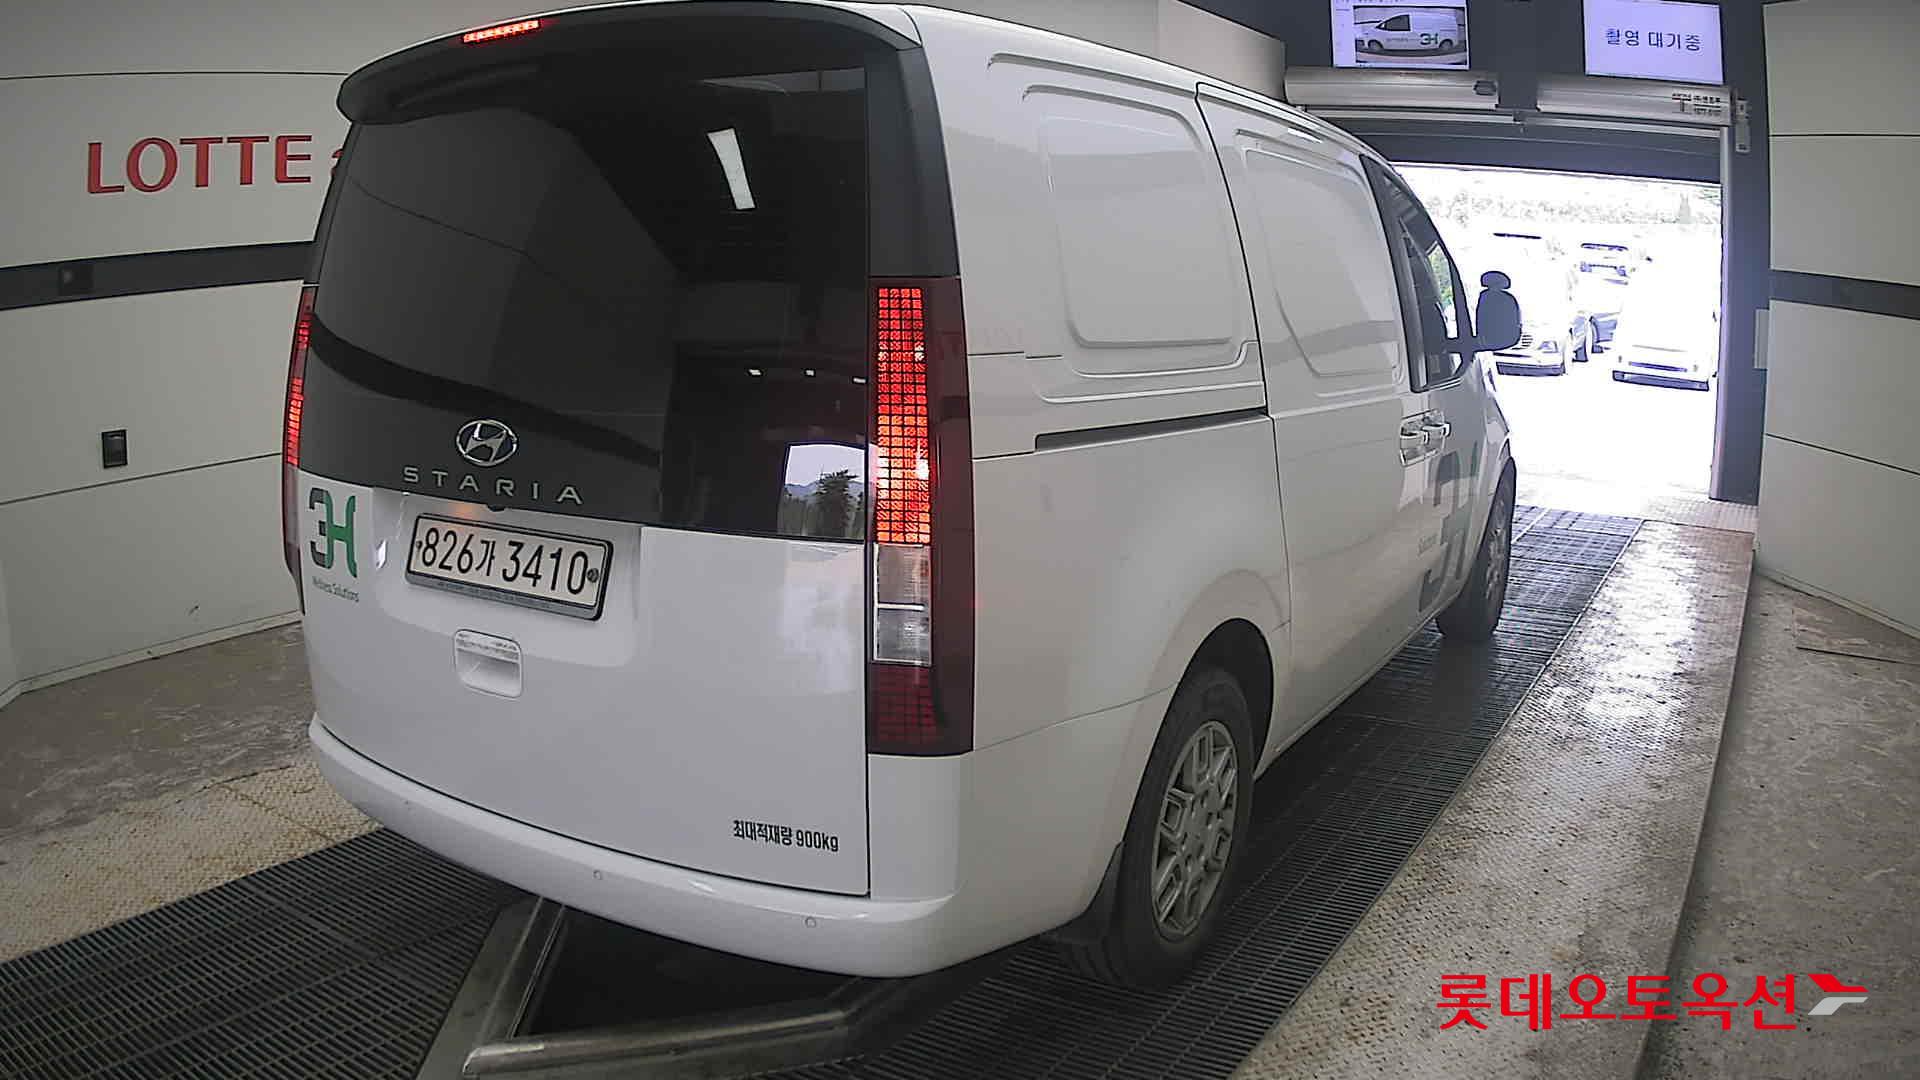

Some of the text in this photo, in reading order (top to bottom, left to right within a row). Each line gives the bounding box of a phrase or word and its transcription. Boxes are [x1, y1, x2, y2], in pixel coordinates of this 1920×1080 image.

[1607, 28, 1701, 51] 촬영 대기중
[87, 135, 313, 194] LOTTE
[402, 466, 584, 506] STARIA
[421, 527, 589, 595] 826가 3410
[733, 819, 839, 852] 최대적재량 900kg
